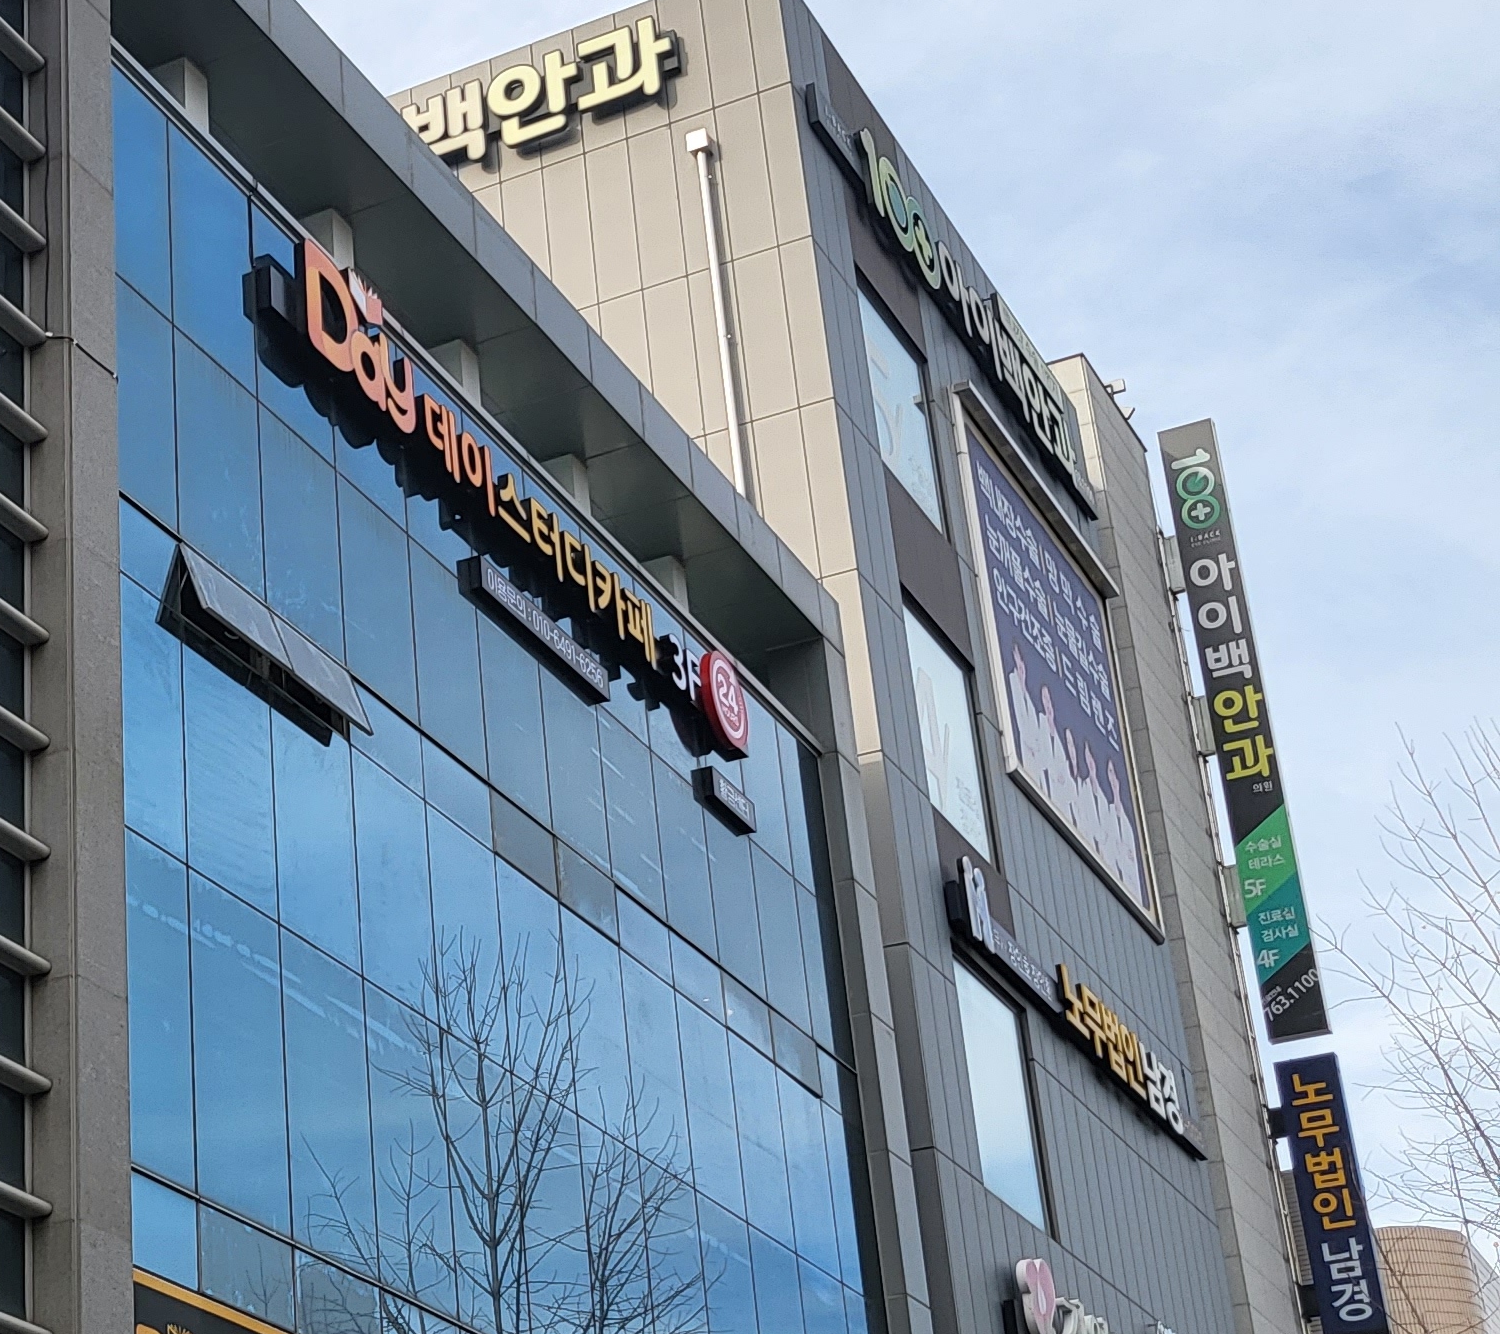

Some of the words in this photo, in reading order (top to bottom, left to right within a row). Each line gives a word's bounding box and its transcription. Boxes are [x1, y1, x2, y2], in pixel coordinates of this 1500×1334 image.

[401, 15, 672, 160] 백안과
[304, 238, 417, 434] Day
[532, 610, 604, 689] 010-6491-6256
[668, 633, 701, 701] 3F
[717, 672, 739, 715] 24
[1252, 780, 1274, 794] 의원
[1244, 835, 1282, 853] 수술실
[1248, 853, 1285, 870] 테라스
[1244, 878, 1267, 898] 5F
[1258, 906, 1296, 925] 진료실
[1260, 923, 1299, 942] 검사실
[1257, 949, 1280, 968] 4F
[1291, 1073, 1357, 1230] 노무법인
[1321, 1236, 1373, 1322] 남경
